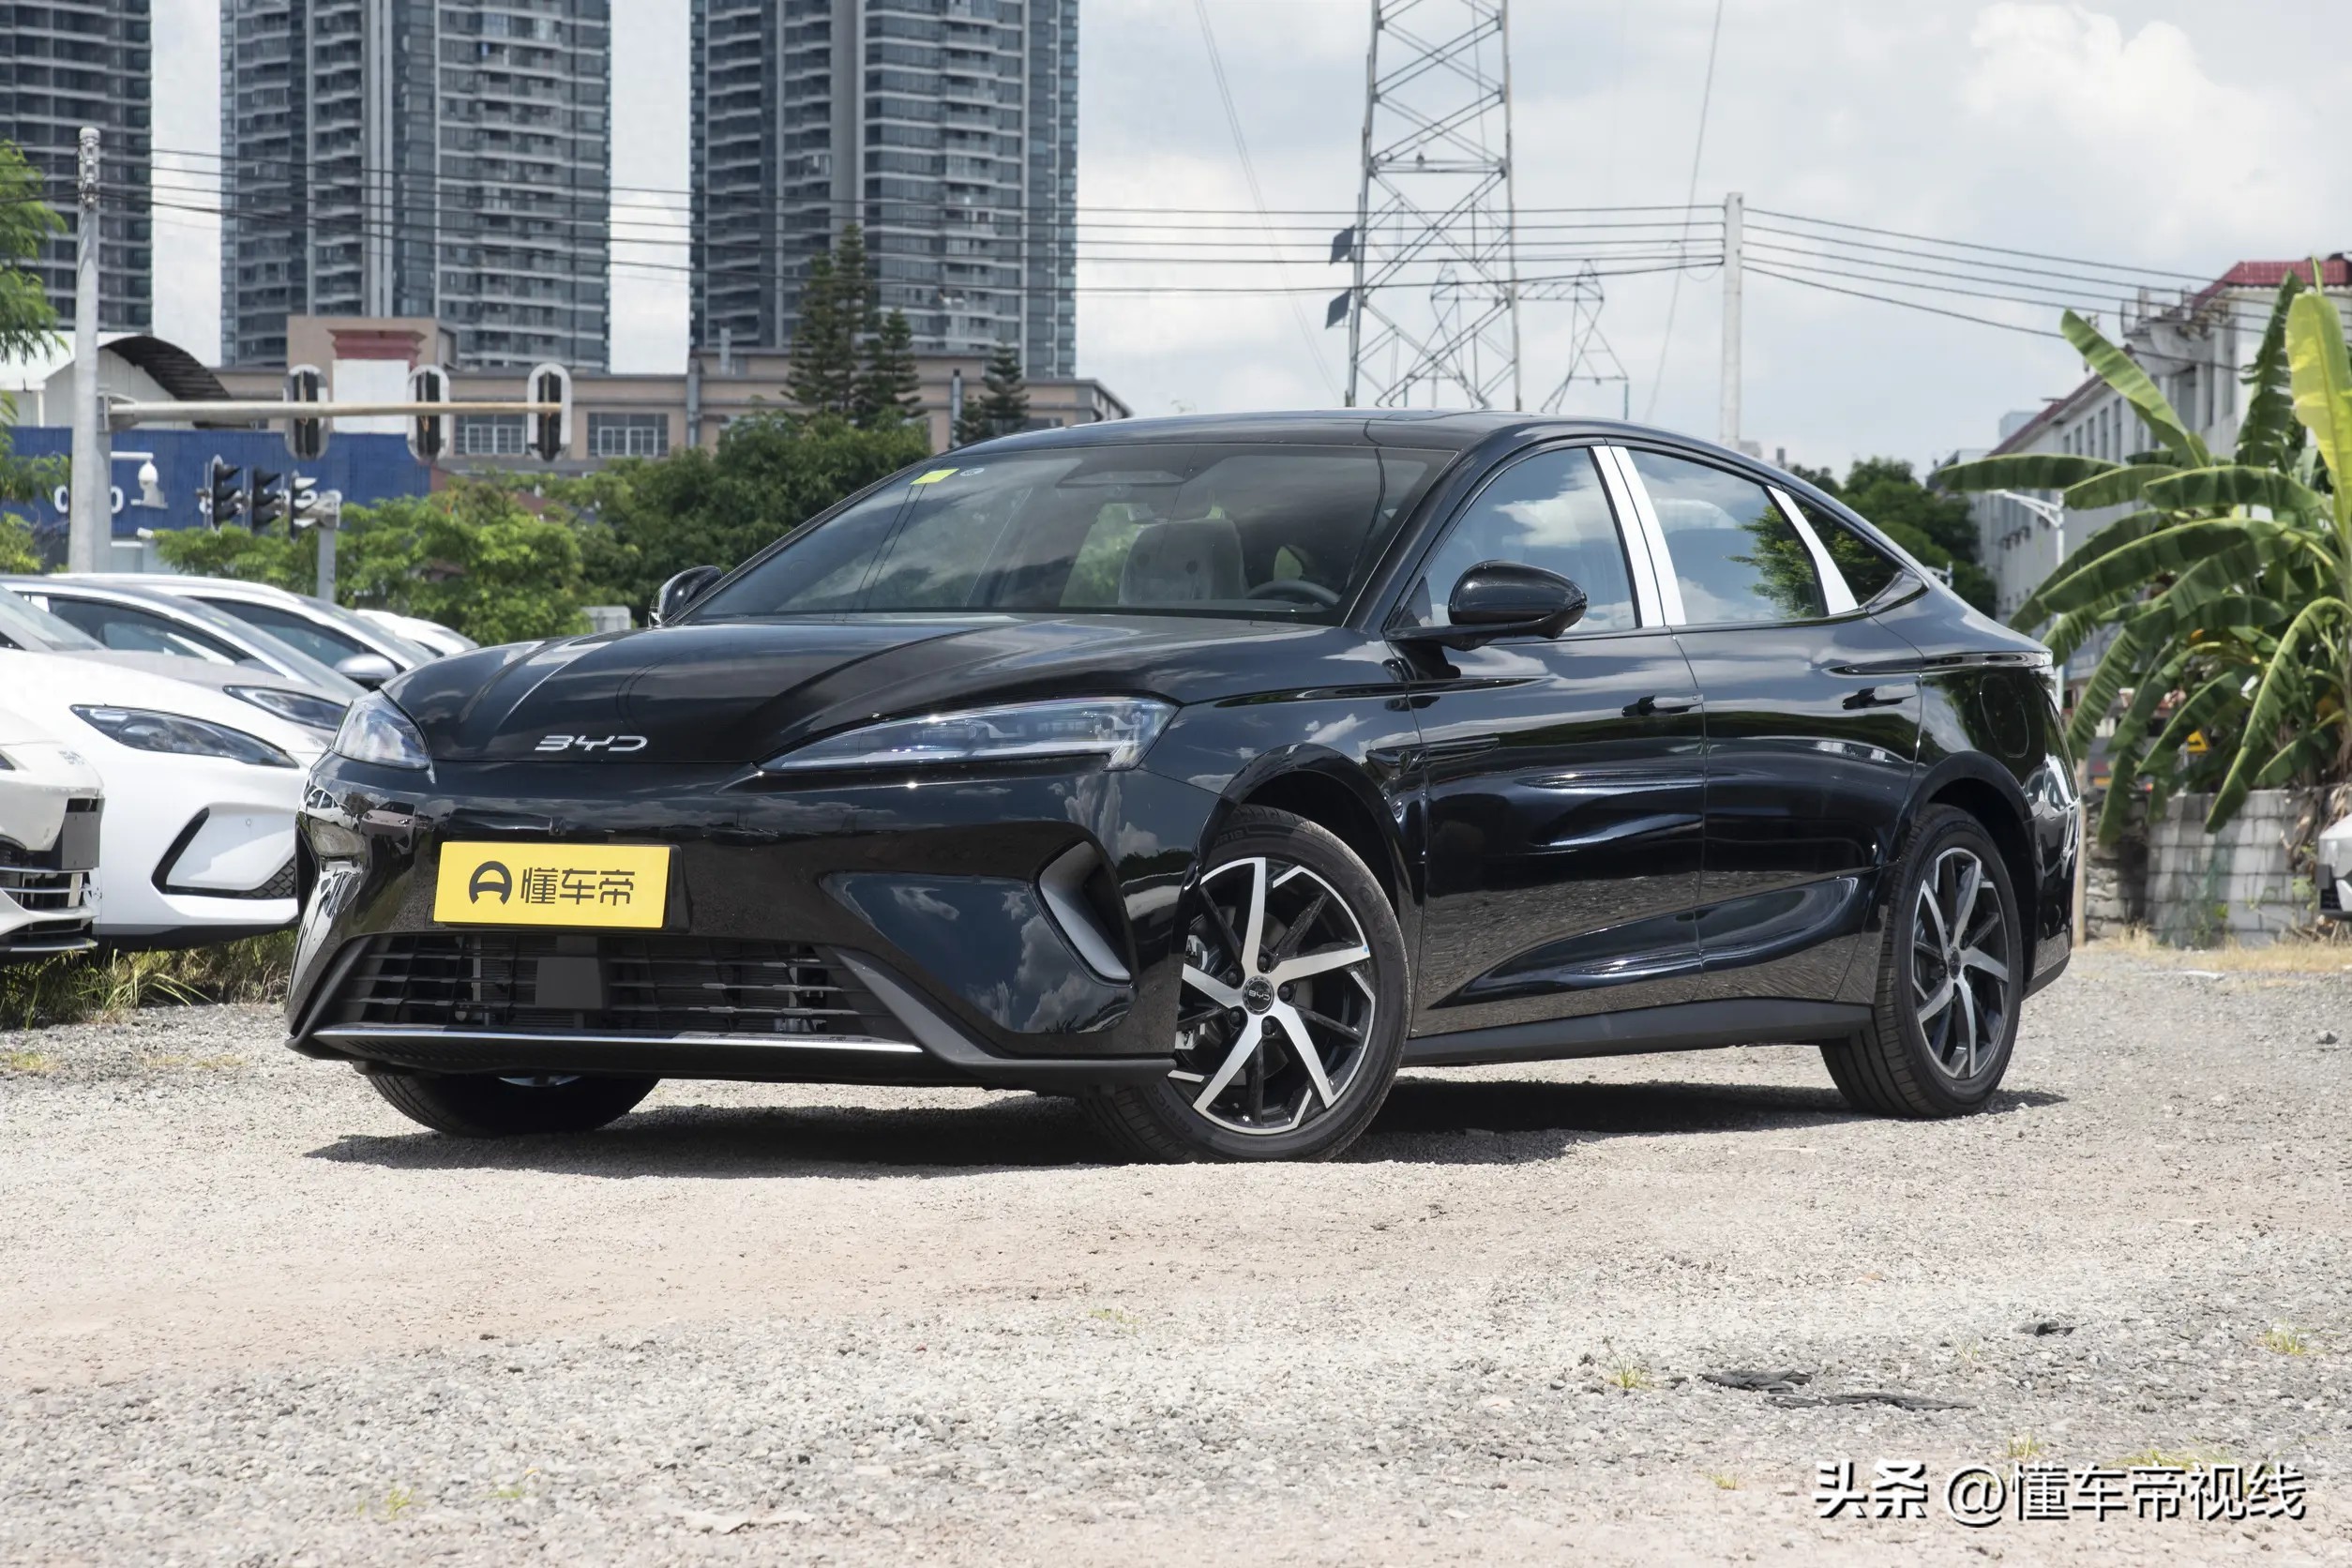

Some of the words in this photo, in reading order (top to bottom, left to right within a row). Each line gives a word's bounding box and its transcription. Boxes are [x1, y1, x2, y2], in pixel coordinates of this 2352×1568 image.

[534, 735, 648, 751] BYD
[520, 867, 636, 906] 懂车帝
[1248, 989, 1271, 1002] BYD
